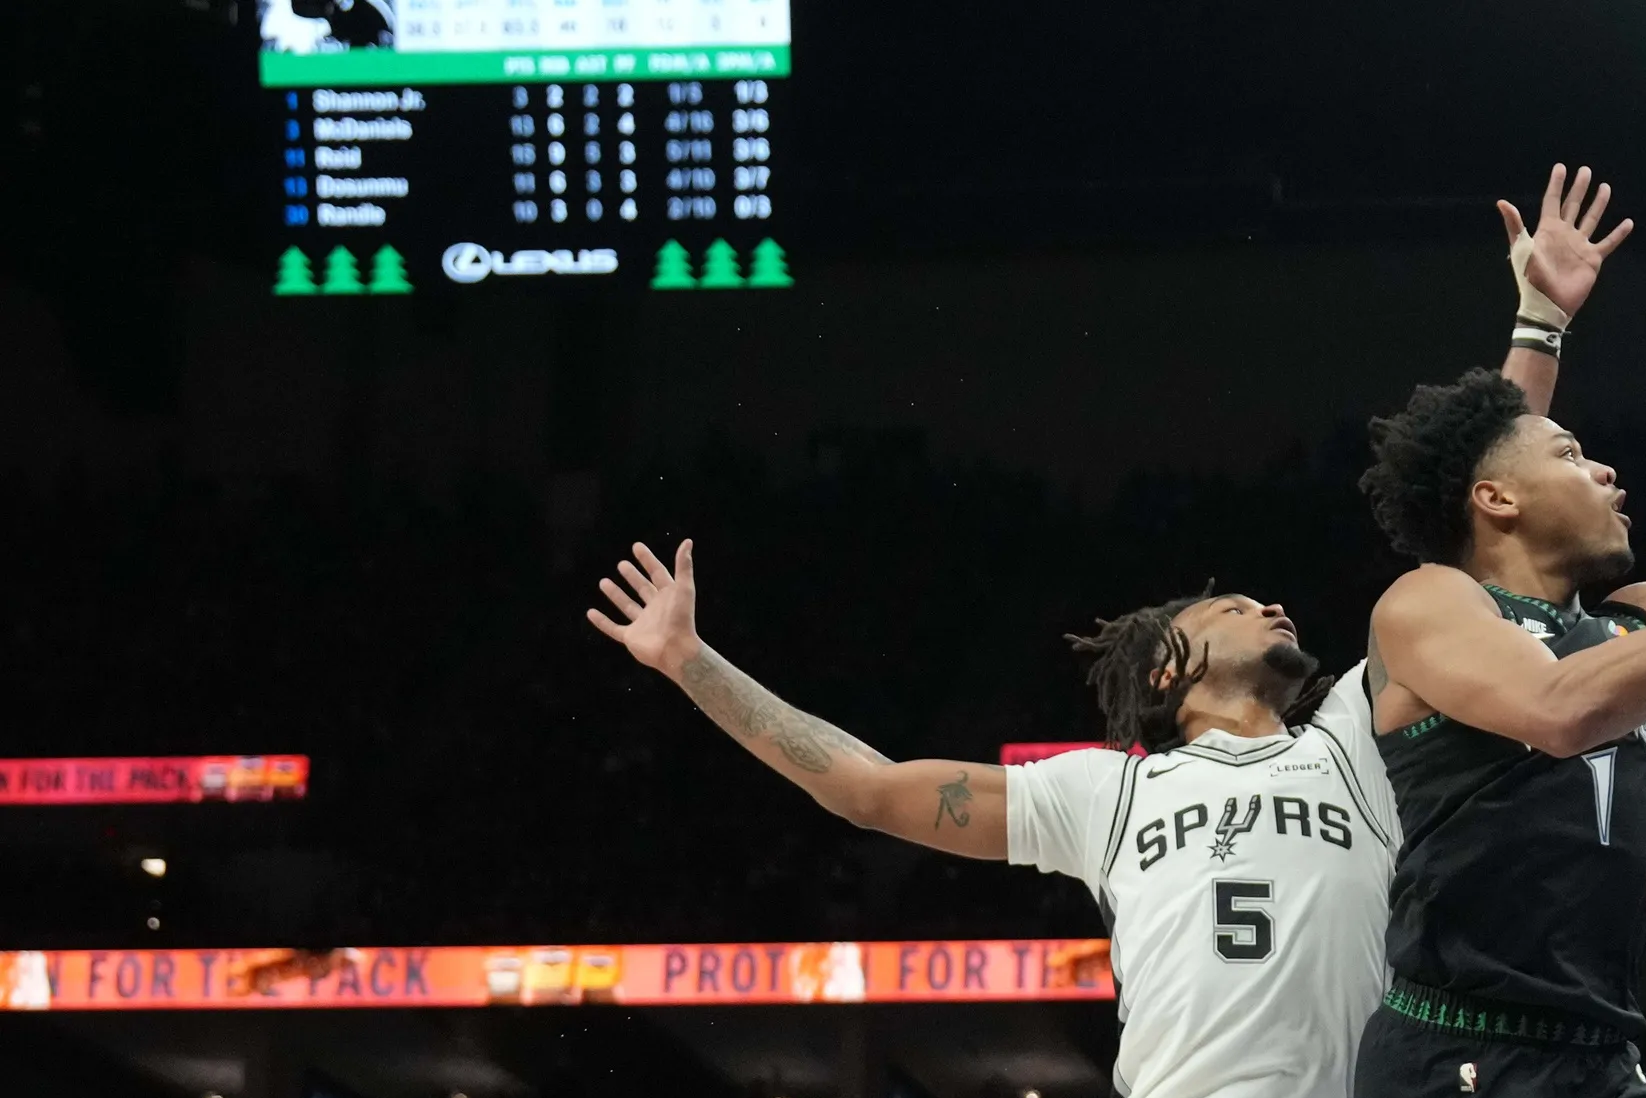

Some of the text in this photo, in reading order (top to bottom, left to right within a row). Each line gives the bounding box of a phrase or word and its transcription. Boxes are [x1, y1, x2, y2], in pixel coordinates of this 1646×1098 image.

[491, 248, 619, 275] LEXUS
[1522, 616, 1547, 633] NIKE
[1276, 762, 1321, 772] LEDGER
[1136, 794, 1352, 872] SPURS
[1212, 878, 1276, 964] 5
[88, 952, 177, 998] FOR
[307, 950, 428, 996] ACK
[899, 947, 987, 990] FOR
